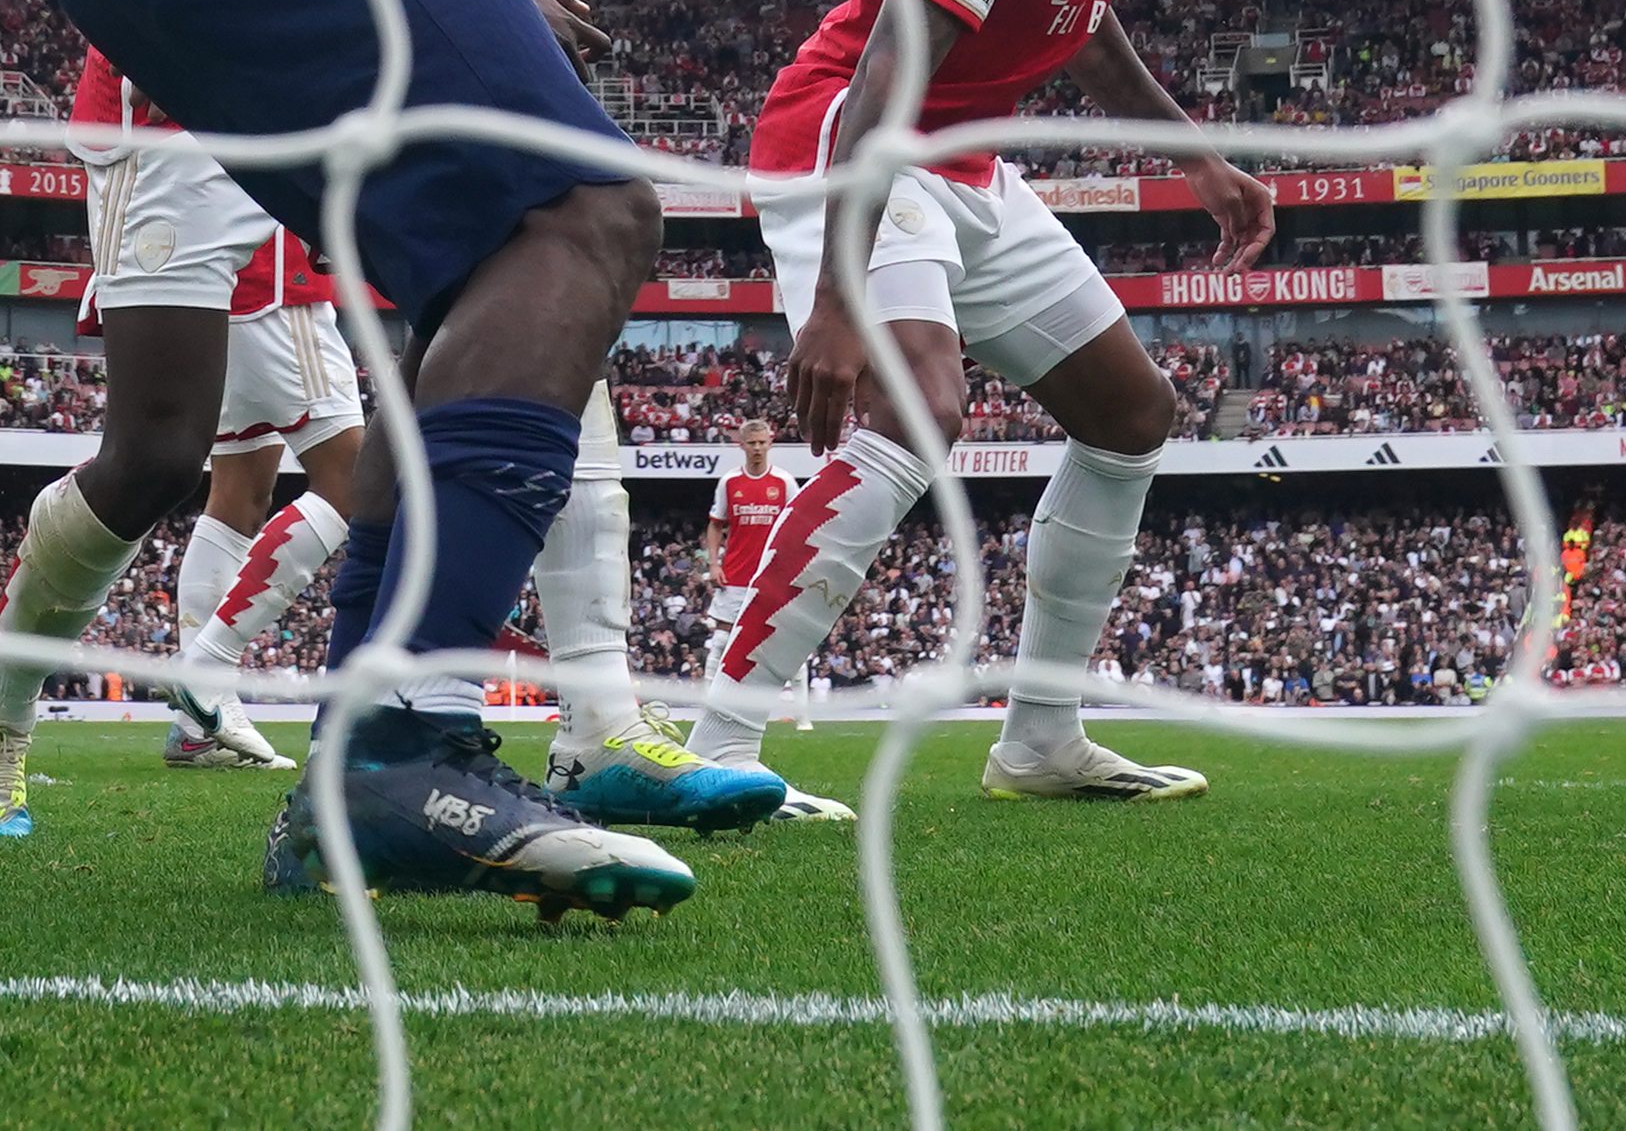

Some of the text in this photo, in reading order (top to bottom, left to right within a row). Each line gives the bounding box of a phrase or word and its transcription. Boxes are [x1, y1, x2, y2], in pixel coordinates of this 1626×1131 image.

[30, 171, 81, 196] 2015
[1297, 177, 1365, 202] 1931
[1426, 169, 1600, 194] Sgapore Gooners
[1172, 274, 1243, 304] HONG
[1274, 270, 1345, 301] KONG
[1528, 264, 1625, 292] Arsenal
[635, 449, 720, 474] betway
[972, 450, 1029, 473] BETTER
